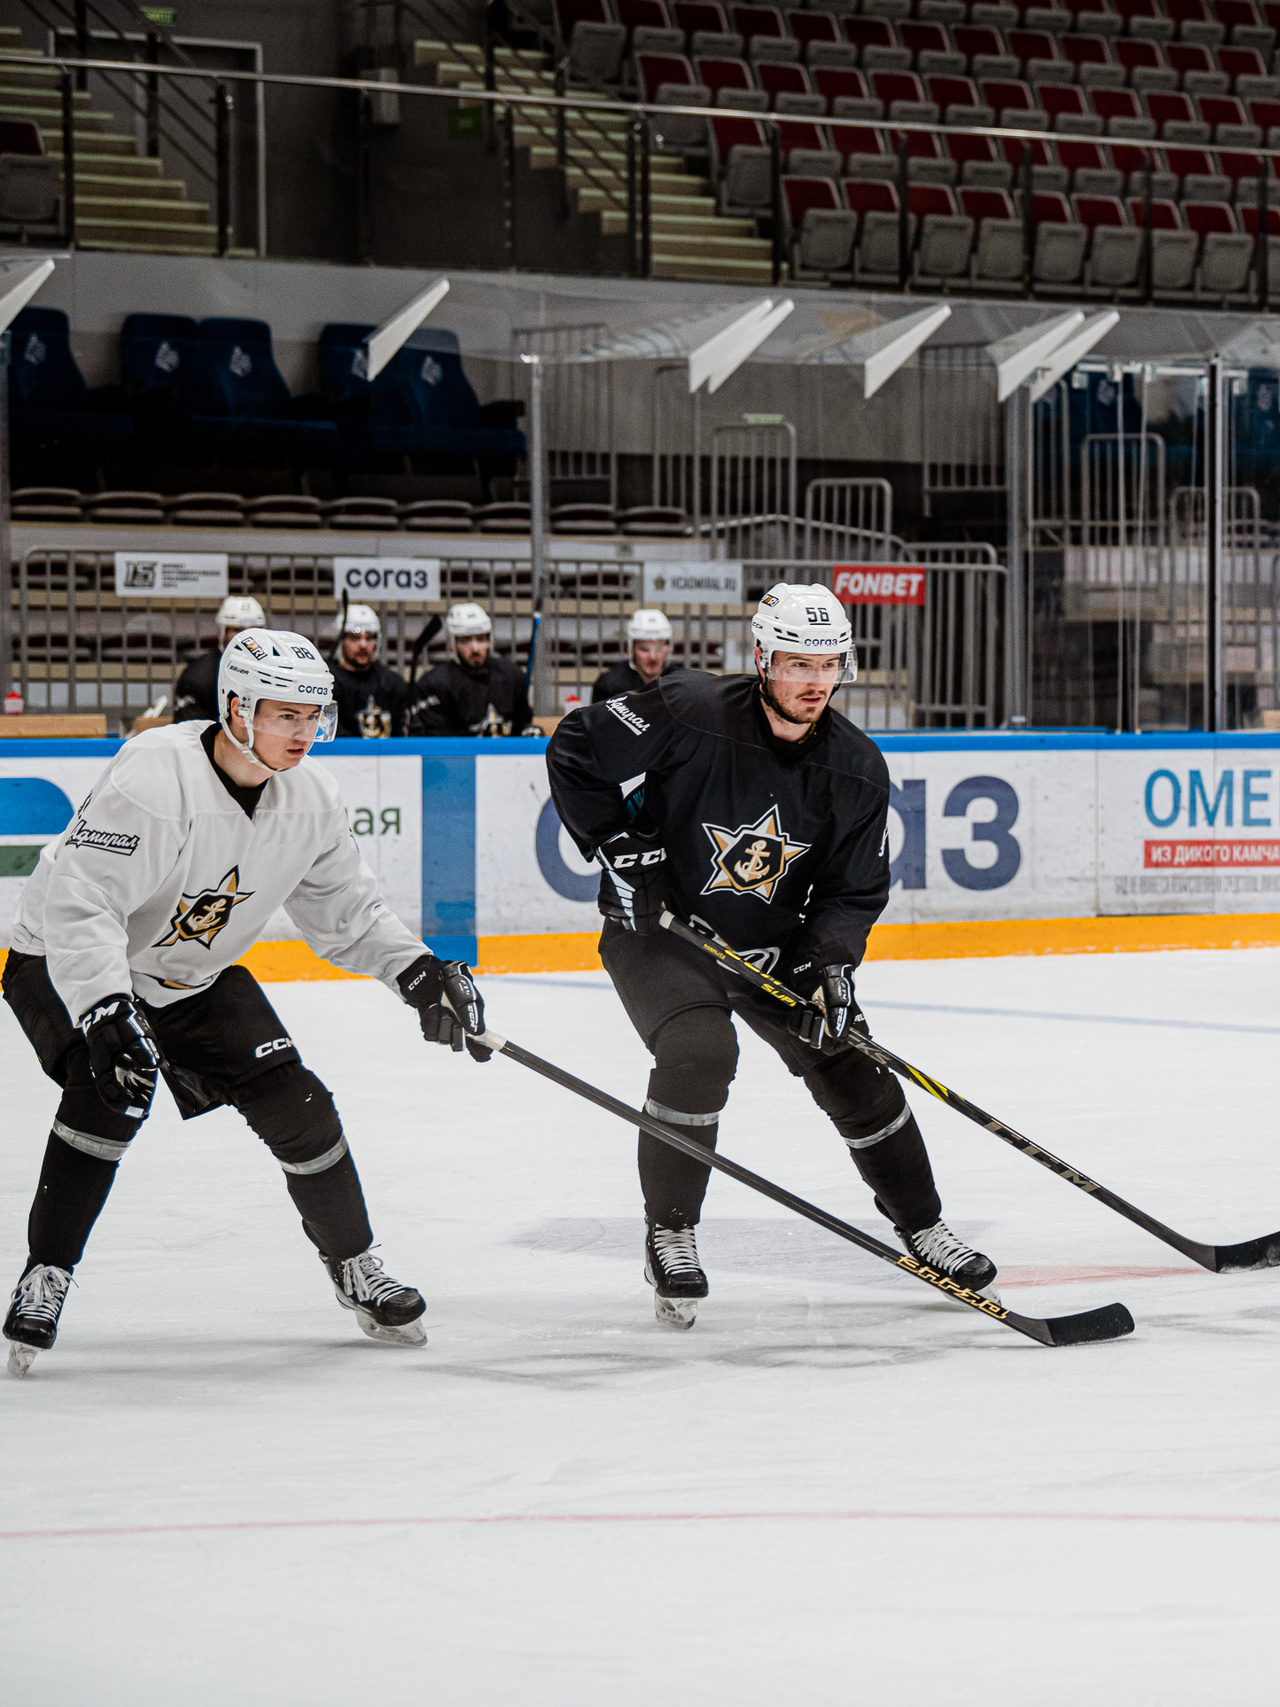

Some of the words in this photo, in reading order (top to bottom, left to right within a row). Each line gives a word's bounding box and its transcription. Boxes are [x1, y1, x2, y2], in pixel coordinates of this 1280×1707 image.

[346, 568, 428, 588] согаз
[835, 572, 923, 597] FONBET
[805, 607, 830, 622] 56
[804, 638, 838, 647] согаз
[291, 646, 315, 660] 88
[298, 684, 329, 696] согаз
[1151, 845, 1171, 862] ИЗ
[1174, 844, 1230, 866] ДИКОГО
[793, 961, 812, 974] CCM
[408, 971, 427, 991] CCM
[761, 983, 797, 1007] SUP
